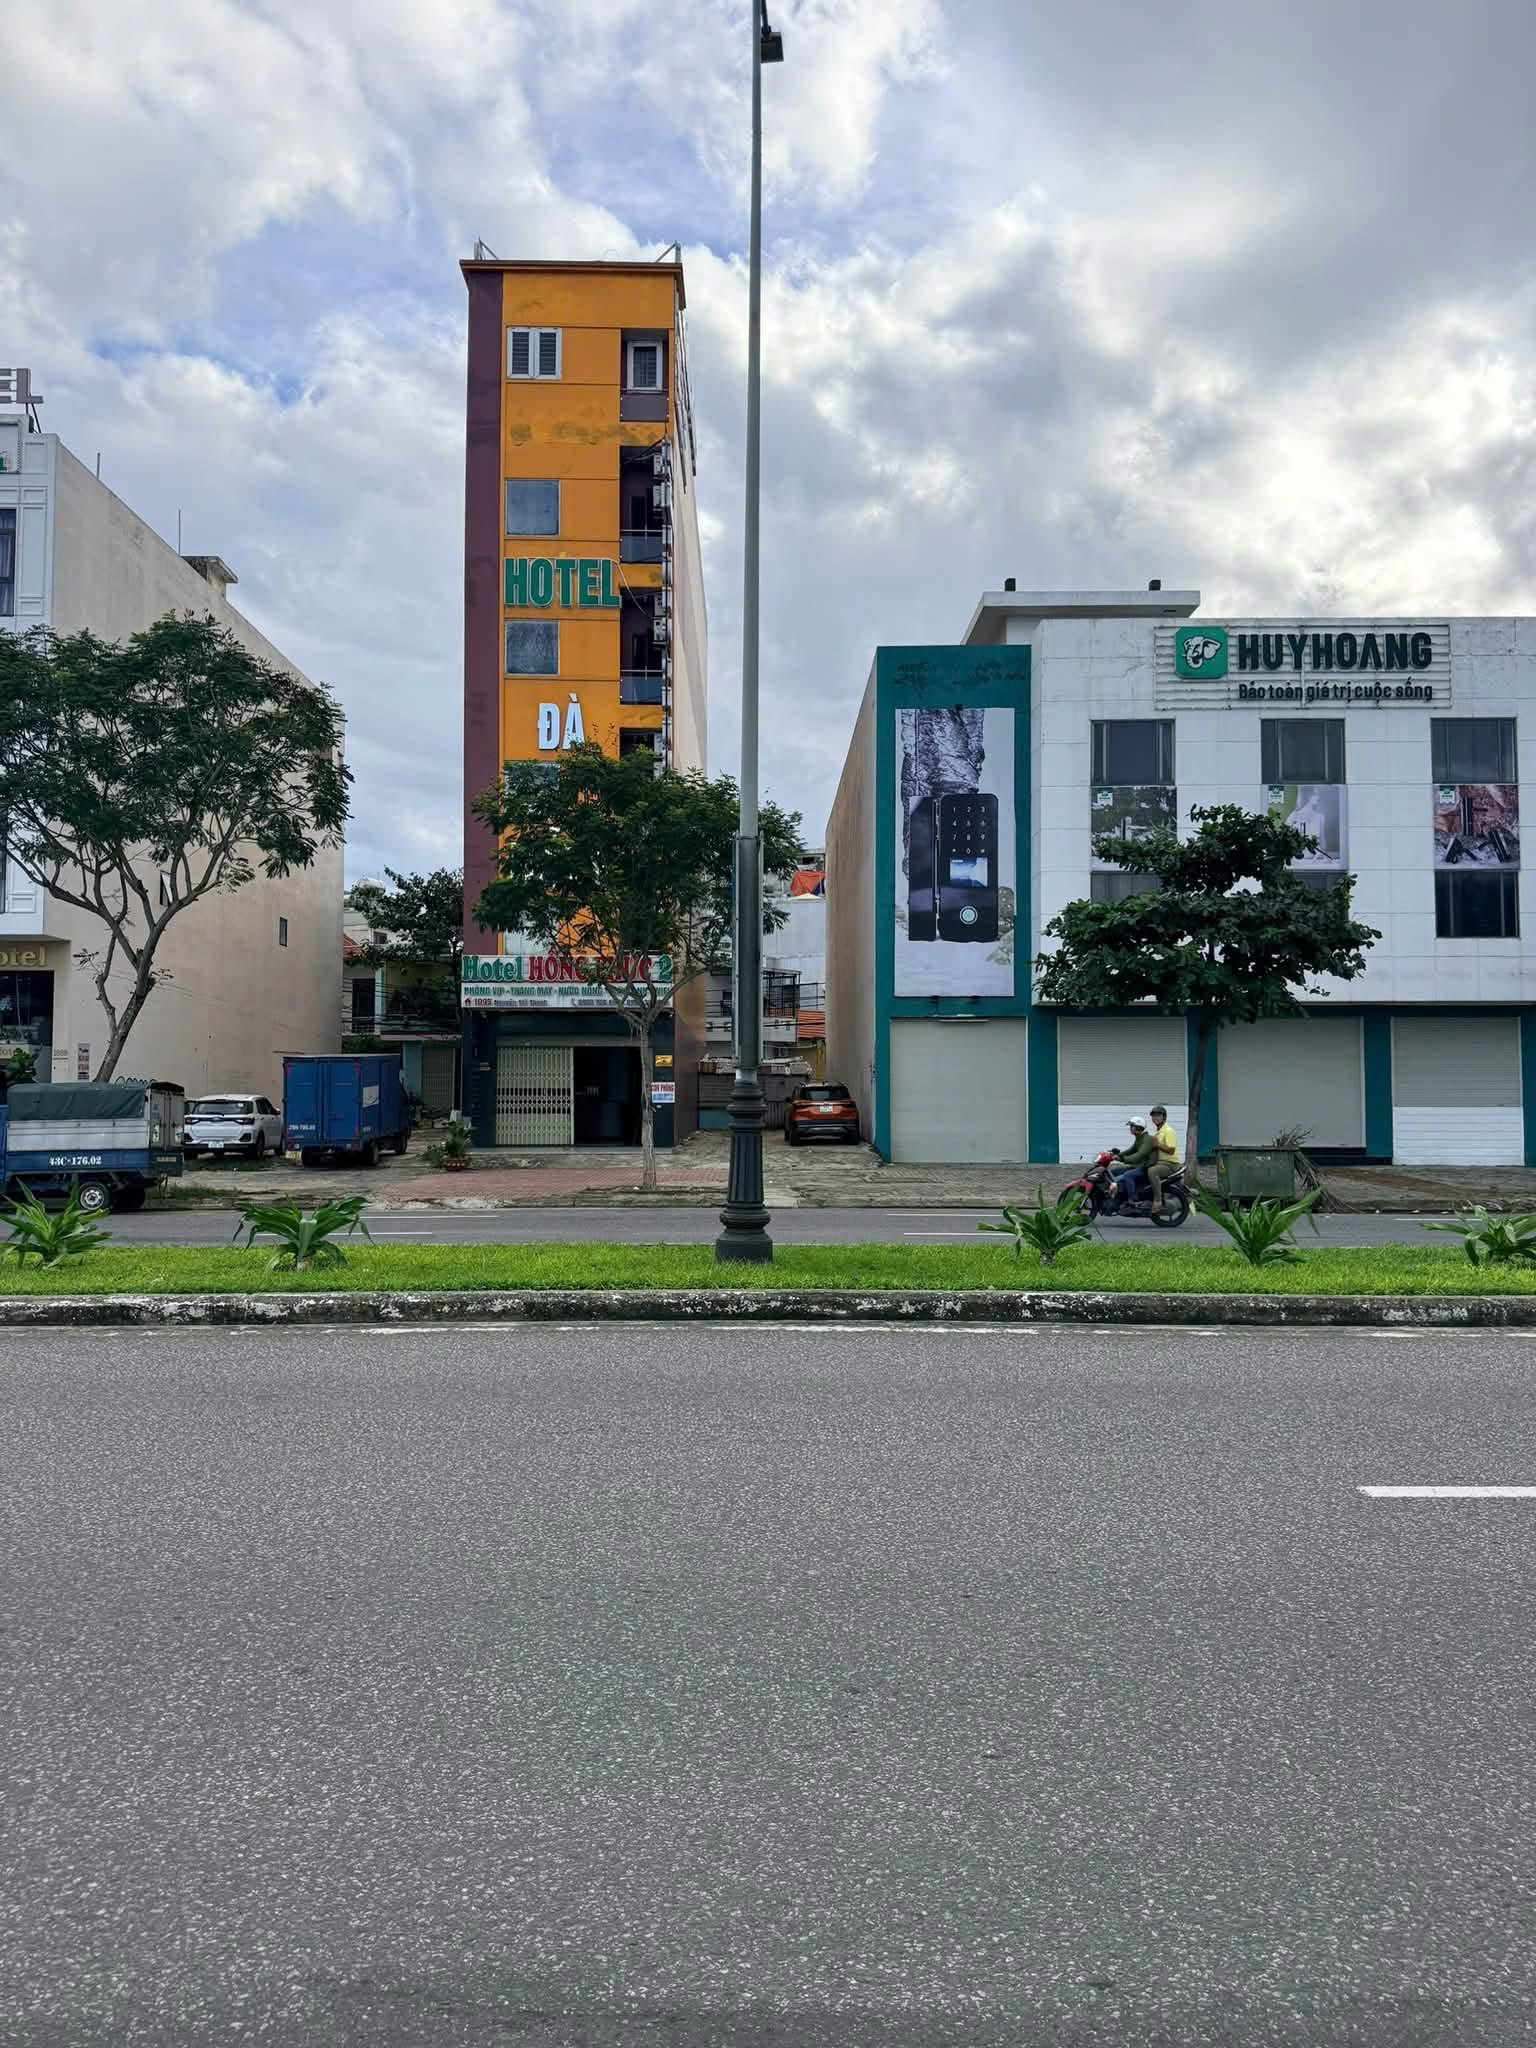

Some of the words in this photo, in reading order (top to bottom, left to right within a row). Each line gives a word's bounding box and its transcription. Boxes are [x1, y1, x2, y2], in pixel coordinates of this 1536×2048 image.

[504, 557, 622, 608] HOTEL
[1238, 632, 1433, 670] HUYHOANG
[1268, 680, 1303, 699] toàn
[1307, 680, 1330, 703] giá
[1333, 681, 1351, 703] trị
[1354, 681, 1392, 704] cuộc
[1395, 676, 1433, 703] sống
[537, 693, 585, 750] ĐÀ
[463, 955, 522, 981] Hotel
[660, 954, 673, 981] 2
